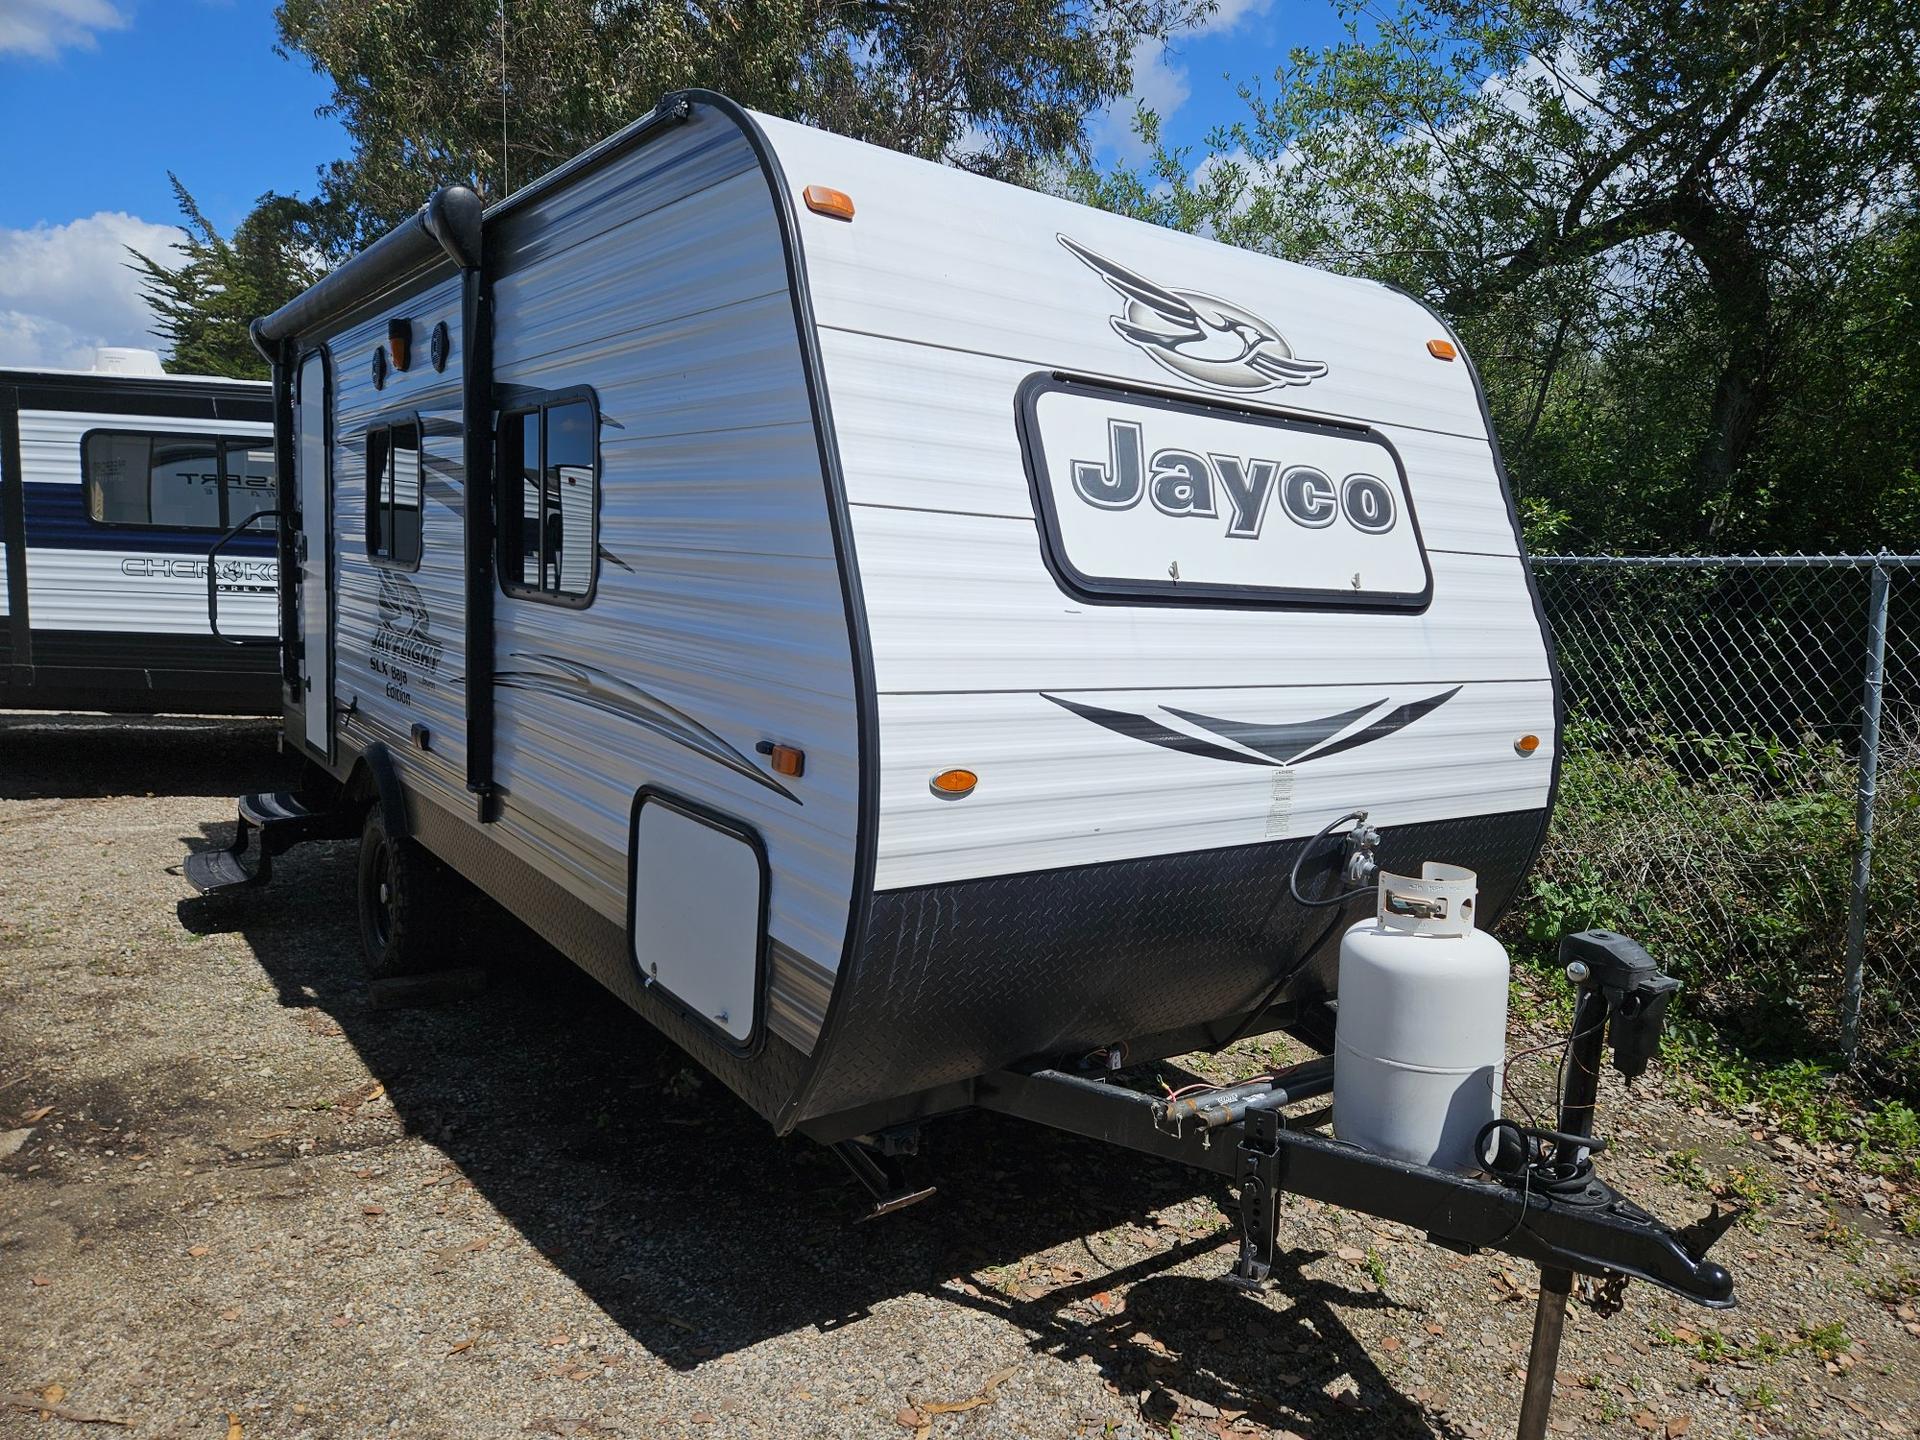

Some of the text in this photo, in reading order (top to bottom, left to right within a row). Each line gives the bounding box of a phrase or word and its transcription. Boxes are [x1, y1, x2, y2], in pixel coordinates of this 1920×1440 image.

[1070, 417, 1397, 540] Jayco
[218, 584, 262, 592] GREY
[370, 657, 388, 676] SLX
[391, 665, 408, 686] Baja
[386, 681, 411, 706] Edition
